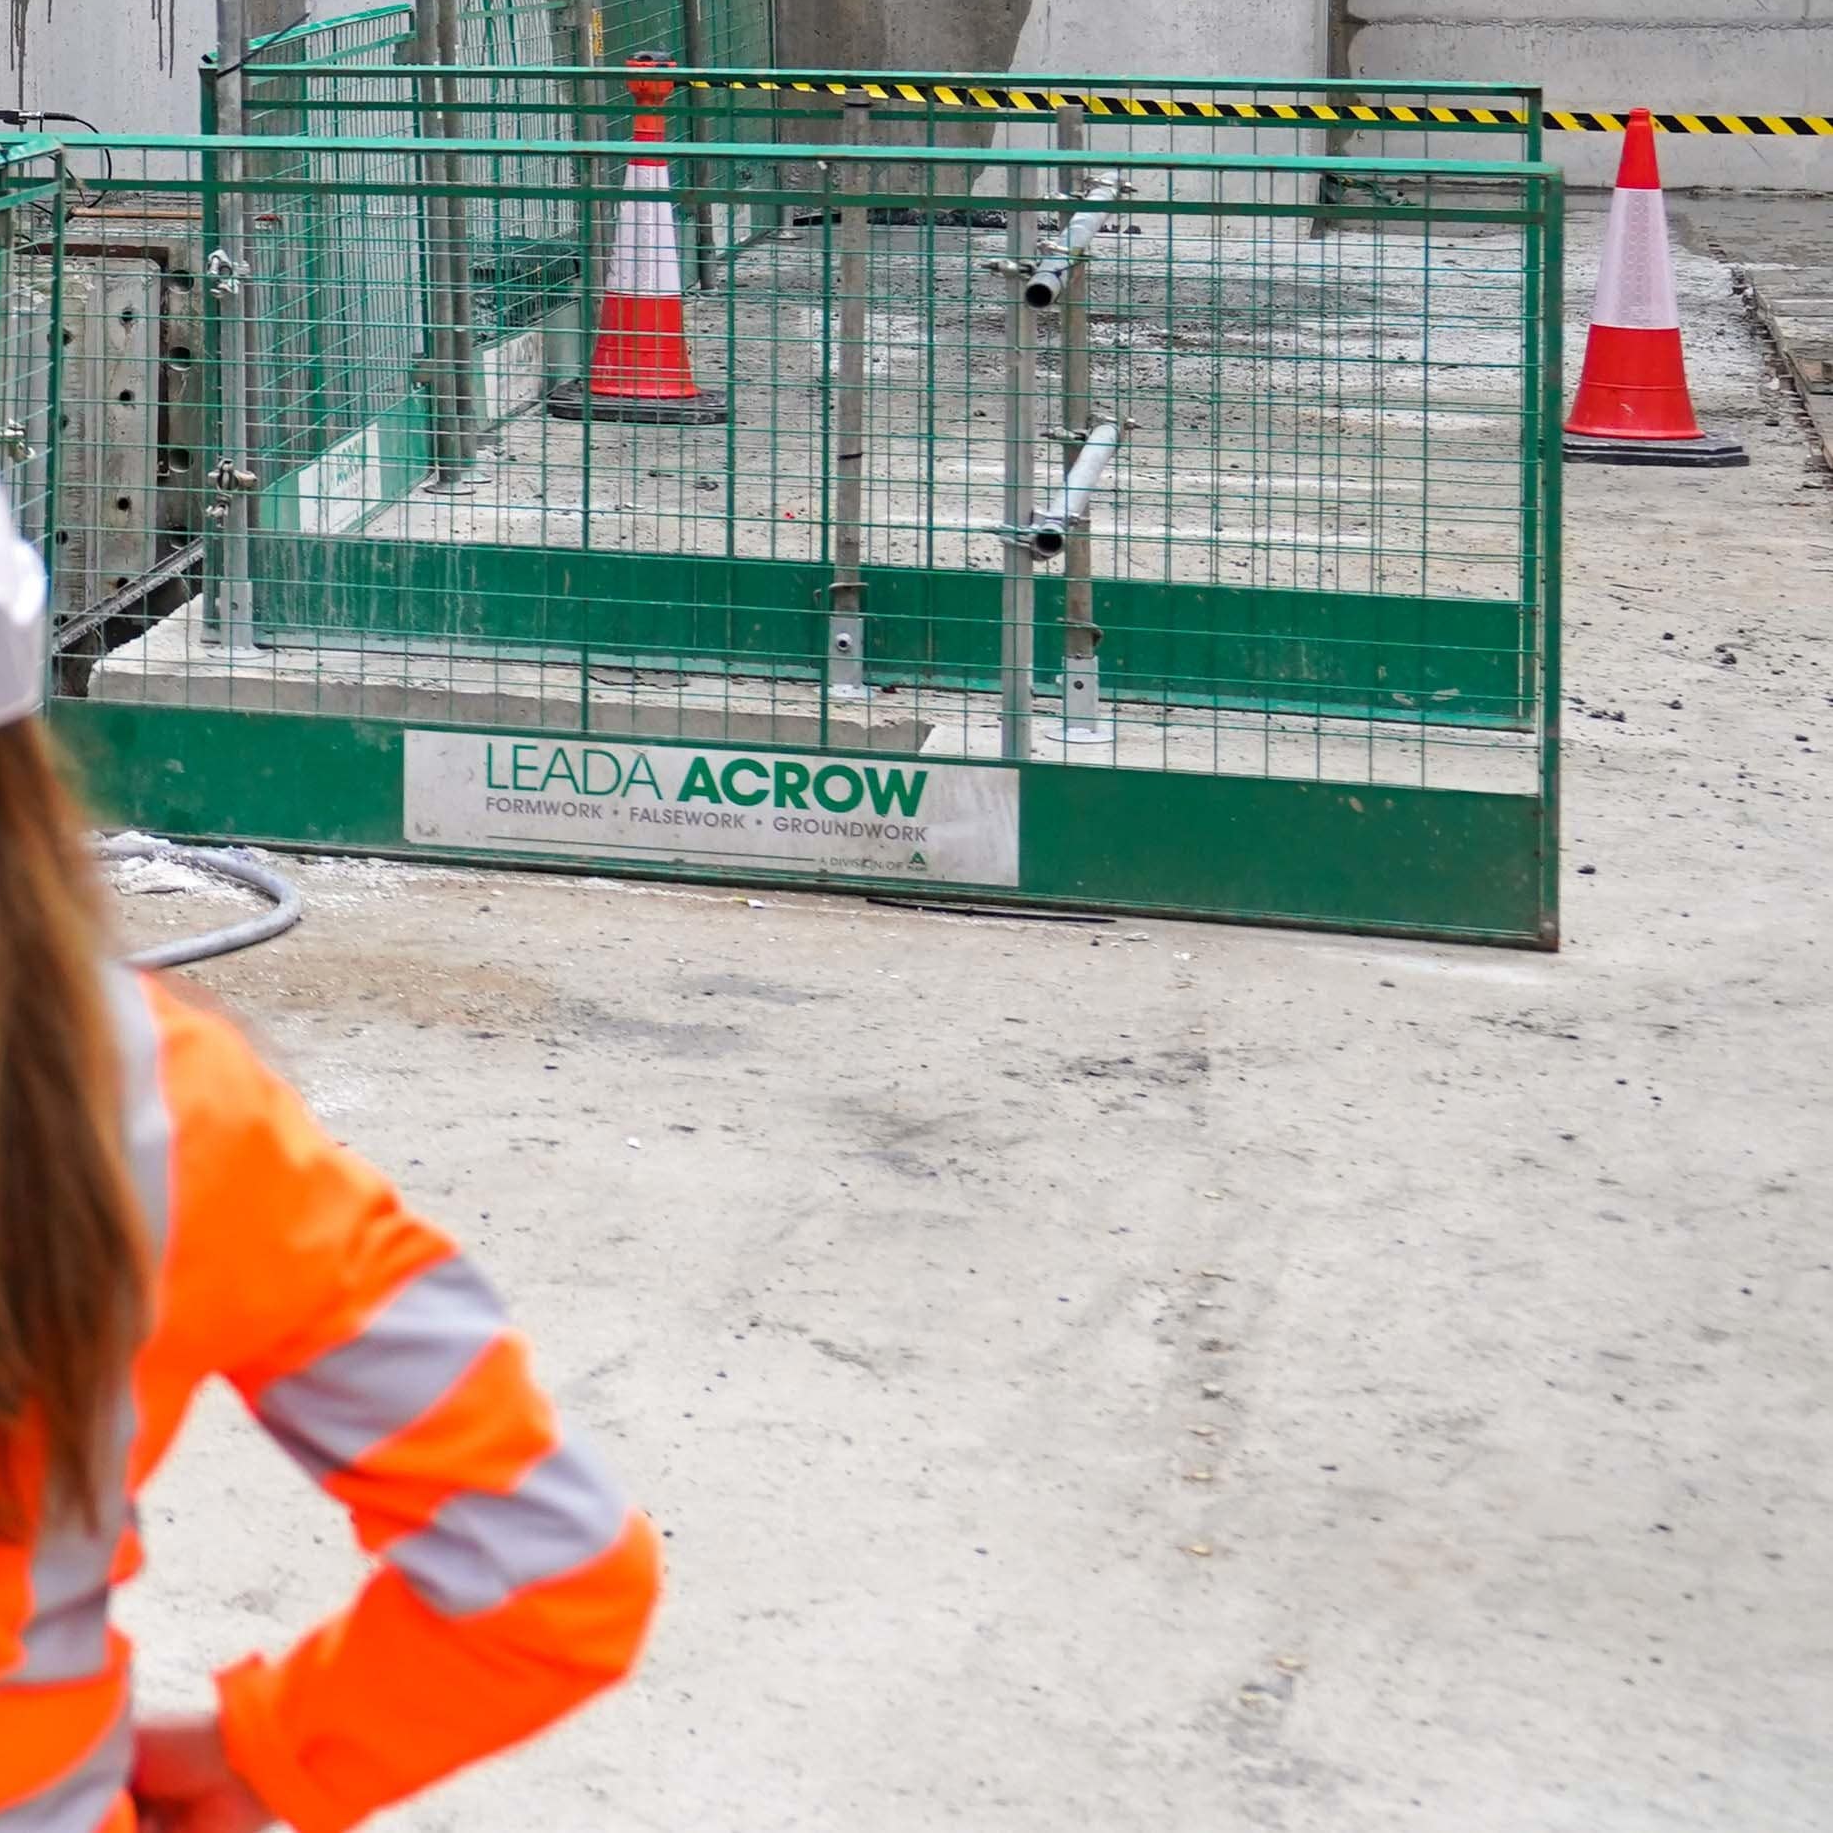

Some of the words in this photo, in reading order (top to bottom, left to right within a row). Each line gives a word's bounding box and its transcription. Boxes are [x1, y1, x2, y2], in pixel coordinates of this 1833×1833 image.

[486, 741, 663, 801] LEADA
[677, 755, 929, 819] ACROW
[485, 796, 603, 821] FORMWORK
[629, 806, 746, 831] FALSEWORK
[772, 815, 928, 843] GROUNDWORK
